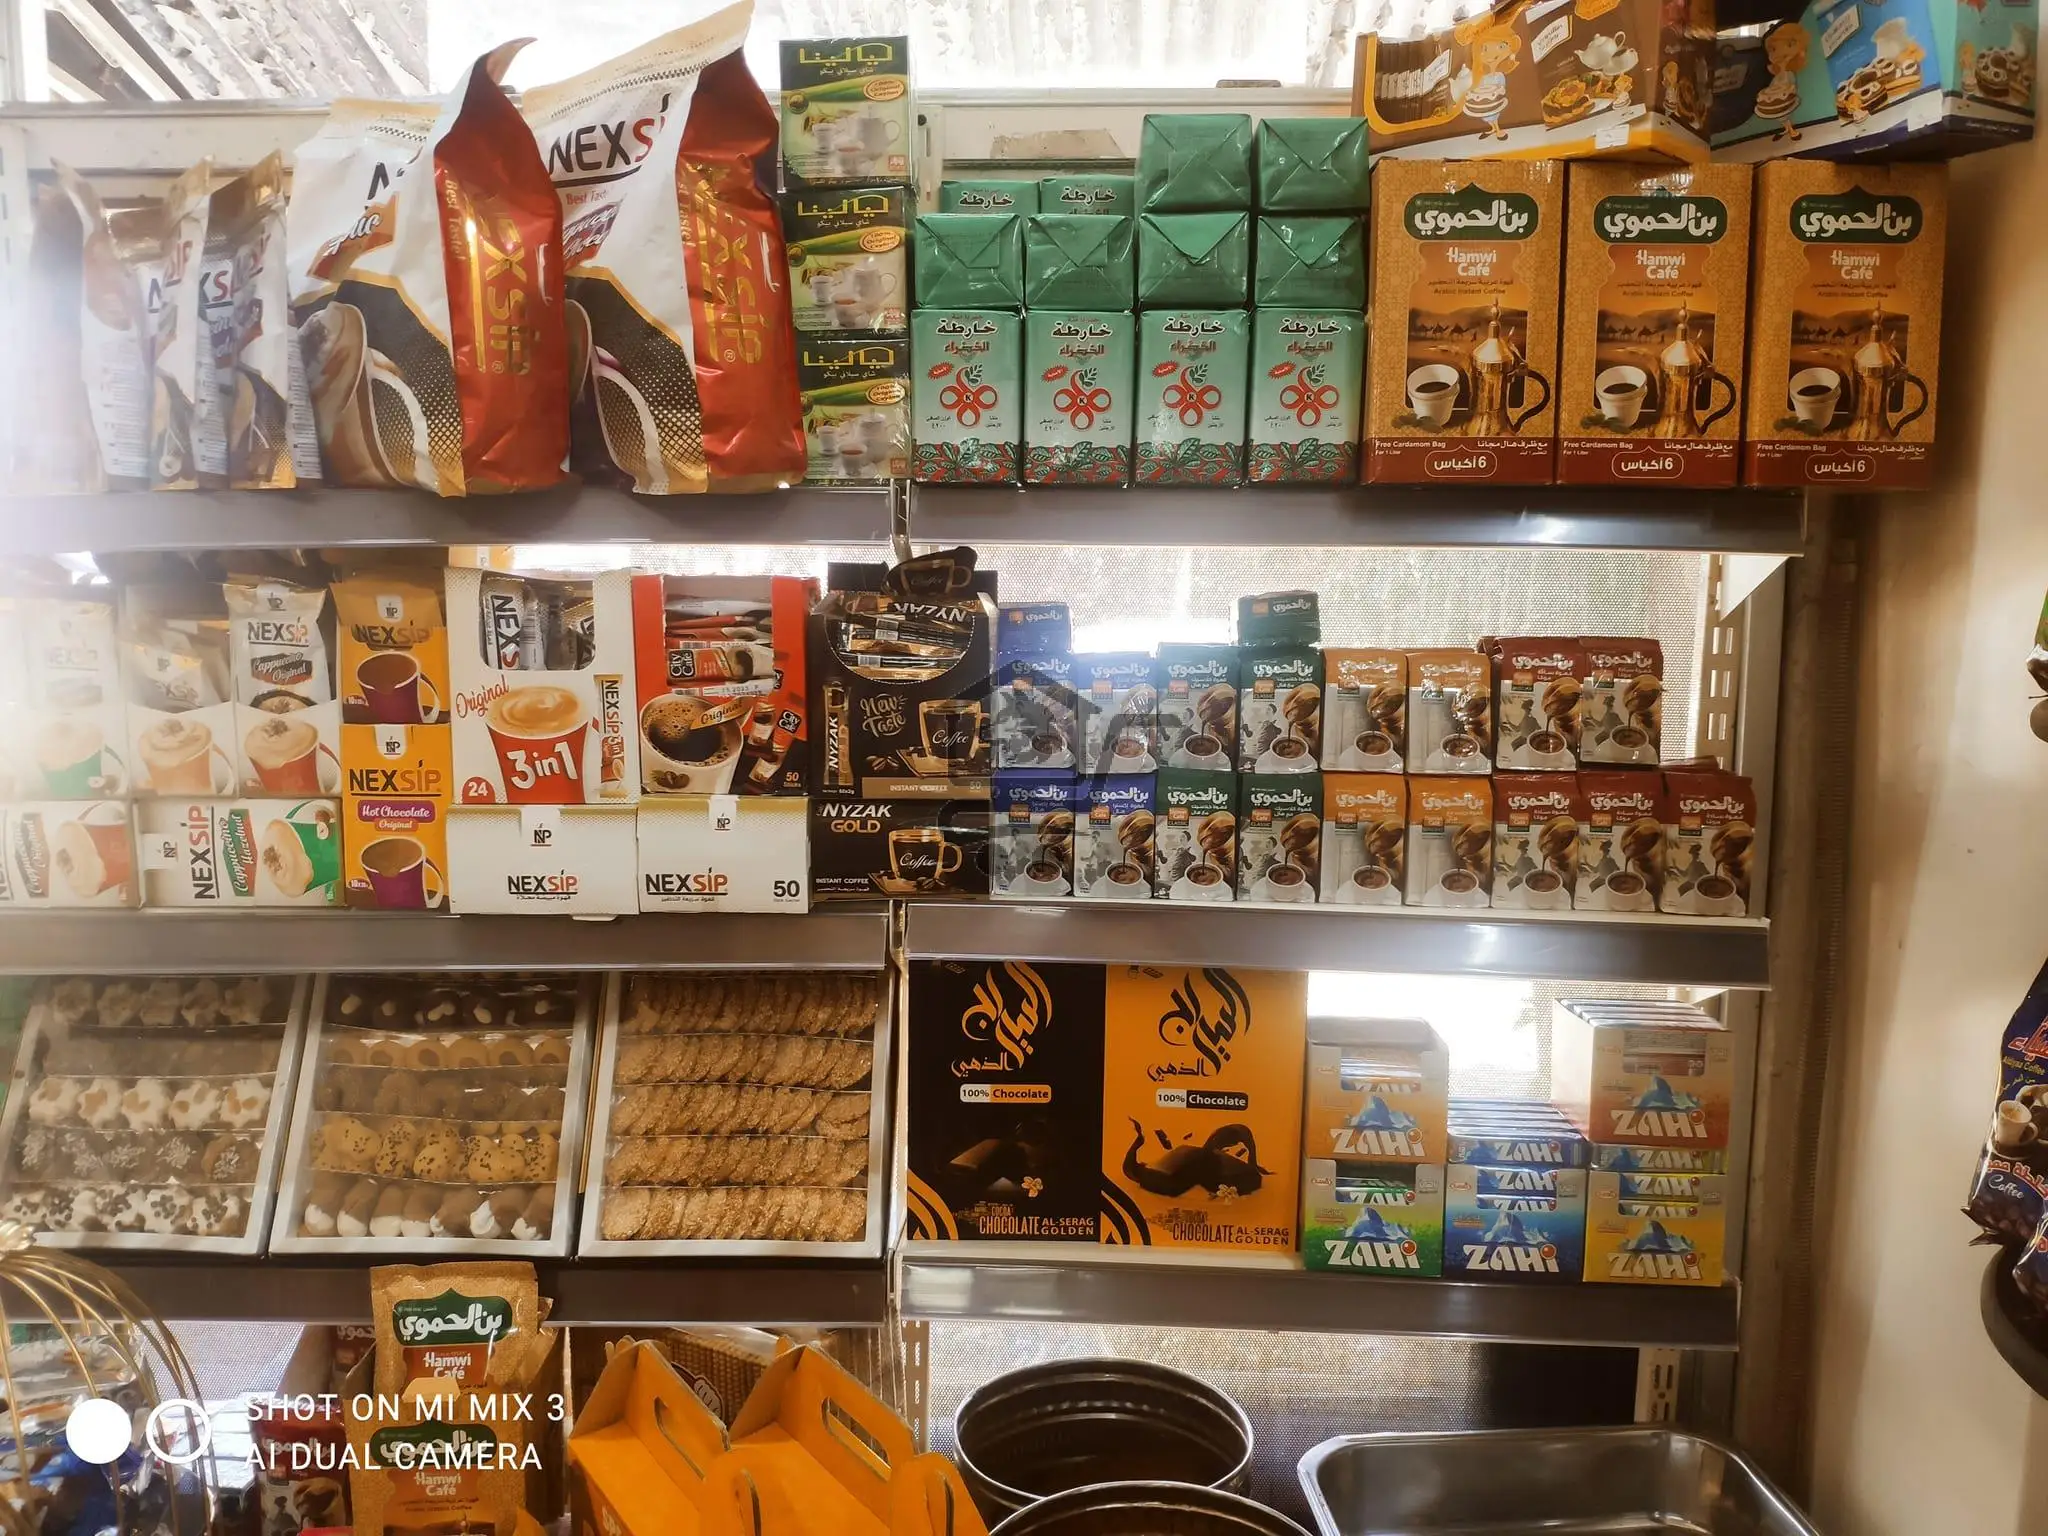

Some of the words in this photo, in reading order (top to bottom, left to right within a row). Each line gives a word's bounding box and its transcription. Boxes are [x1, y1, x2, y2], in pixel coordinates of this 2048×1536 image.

[959, 192, 1014, 209] خارطة
[1060, 187, 1116, 204] خارطة
[1414, 199, 1507, 236] الحموي
[1500, 205, 1529, 234] بن
[1602, 202, 1696, 239] الحموي
[1688, 209, 1718, 238] بن
[1799, 202, 1891, 239] الحموي
[1883, 209, 1913, 238] بن
[1446, 246, 1497, 263] Hamwi
[1635, 250, 1687, 267] Hamwi
[1830, 250, 1881, 268] Hamwi
[1457, 261, 1491, 277] Café
[1645, 265, 1679, 281] Café
[1841, 264, 1874, 281] Café
[936, 320, 999, 339] خارطة
[1052, 321, 1113, 340] خارطة
[1162, 317, 1226, 338] خارطة
[1279, 317, 1343, 338] خارطة
[944, 340, 990, 354] الخضراء
[1058, 343, 1105, 357] الخضراء
[1169, 340, 1217, 354] الخضراء
[1286, 340, 1334, 355] الخضراء
[965, 393, 972, 402] K
[1079, 396, 1086, 405] K
[1188, 393, 1195, 401] K
[1306, 393, 1313, 401] K
[1375, 440, 1392, 448] Free
[1393, 440, 1431, 448] Cardamom
[1432, 440, 1447, 450] Bag
[1563, 441, 1581, 449] Free
[1581, 441, 1618, 449] Cardamom
[1619, 441, 1634, 451] Bag
[1433, 456, 1477, 471] أكياس
[1478, 457, 1487, 469] 6
[1620, 457, 1663, 471] أكياس
[1664, 458, 1674, 470] 6
[1814, 460, 1857, 474] أكياس
[1857, 461, 1866, 473] 6
[894, 602, 967, 623] NYZAK
[1272, 599, 1304, 614] الحموي
[1025, 610, 1057, 623] الحموي
[247, 617, 309, 642] NEXSIP
[353, 620, 431, 646] NEXSIP
[671, 653, 683, 677] City
[1011, 658, 1060, 674] الحموي
[1511, 653, 1564, 670] الحموي
[1591, 650, 1642, 668] الحموي
[272, 663, 307, 683] Original
[1090, 662, 1139, 678] الحموي
[1168, 660, 1217, 678] الحموي
[1253, 660, 1303, 678] الحموي
[455, 674, 510, 718] Original
[860, 693, 899, 717] New
[604, 679, 621, 734] NEXSIP
[700, 701, 743, 724] Original
[783, 710, 800, 725] City
[862, 711, 906, 738] Taste
[828, 715, 839, 769] NYZAK
[932, 729, 969, 748] Coffee
[350, 763, 443, 793] NEXSIP
[785, 771, 800, 782] 50
[467, 781, 488, 797] 24
[889, 784, 919, 792] INSTANT
[1008, 784, 1057, 802] الحموي
[1089, 786, 1138, 804] الحموي
[1167, 787, 1217, 805] الحموي
[1250, 788, 1301, 807] الحموي
[1335, 790, 1386, 807] الحموي
[1422, 792, 1471, 810] الحموي
[1507, 791, 1560, 810] الحموي
[1590, 792, 1643, 811] الحموي
[1679, 796, 1733, 813] الحموي
[362, 804, 381, 818] Hot
[380, 804, 431, 819] Chocolate
[822, 803, 892, 818] NYZAK
[379, 819, 413, 831] Original
[830, 819, 881, 833] GOLD
[233, 813, 249, 866] Hazelnut
[186, 805, 217, 900] NEXSIP
[220, 817, 241, 894] Cappuccino
[899, 852, 938, 870] Coffee
[507, 869, 578, 893] NEXSIP
[645, 866, 729, 894] NEXSIP
[773, 879, 800, 898] 50
[951, 1051, 1015, 1078] الذهبي
[1147, 1057, 1212, 1082] الذهبي
[962, 1088, 990, 1099] 100%
[992, 1088, 1049, 1099] Chocolate
[1157, 1093, 1186, 1104] 100%
[1188, 1094, 1247, 1107] Chocolate
[1988, 1174, 2025, 1199] Coffee
[979, 1215, 1040, 1235] CHOCOLATE
[1041, 1217, 1094, 1226] AL-SERAG
[1041, 1226, 1094, 1235] GOLDEN
[1172, 1223, 1235, 1243] CHOCOLATE
[1235, 1227, 1290, 1237] AL-SERAG
[1235, 1236, 1290, 1246] GOLDEN
[398, 1302, 484, 1341] الحموي
[478, 1308, 503, 1337] بن
[423, 1350, 472, 1368] Hamwi
[413, 1470, 462, 1485] Hamwi
[425, 1483, 457, 1497] Café
